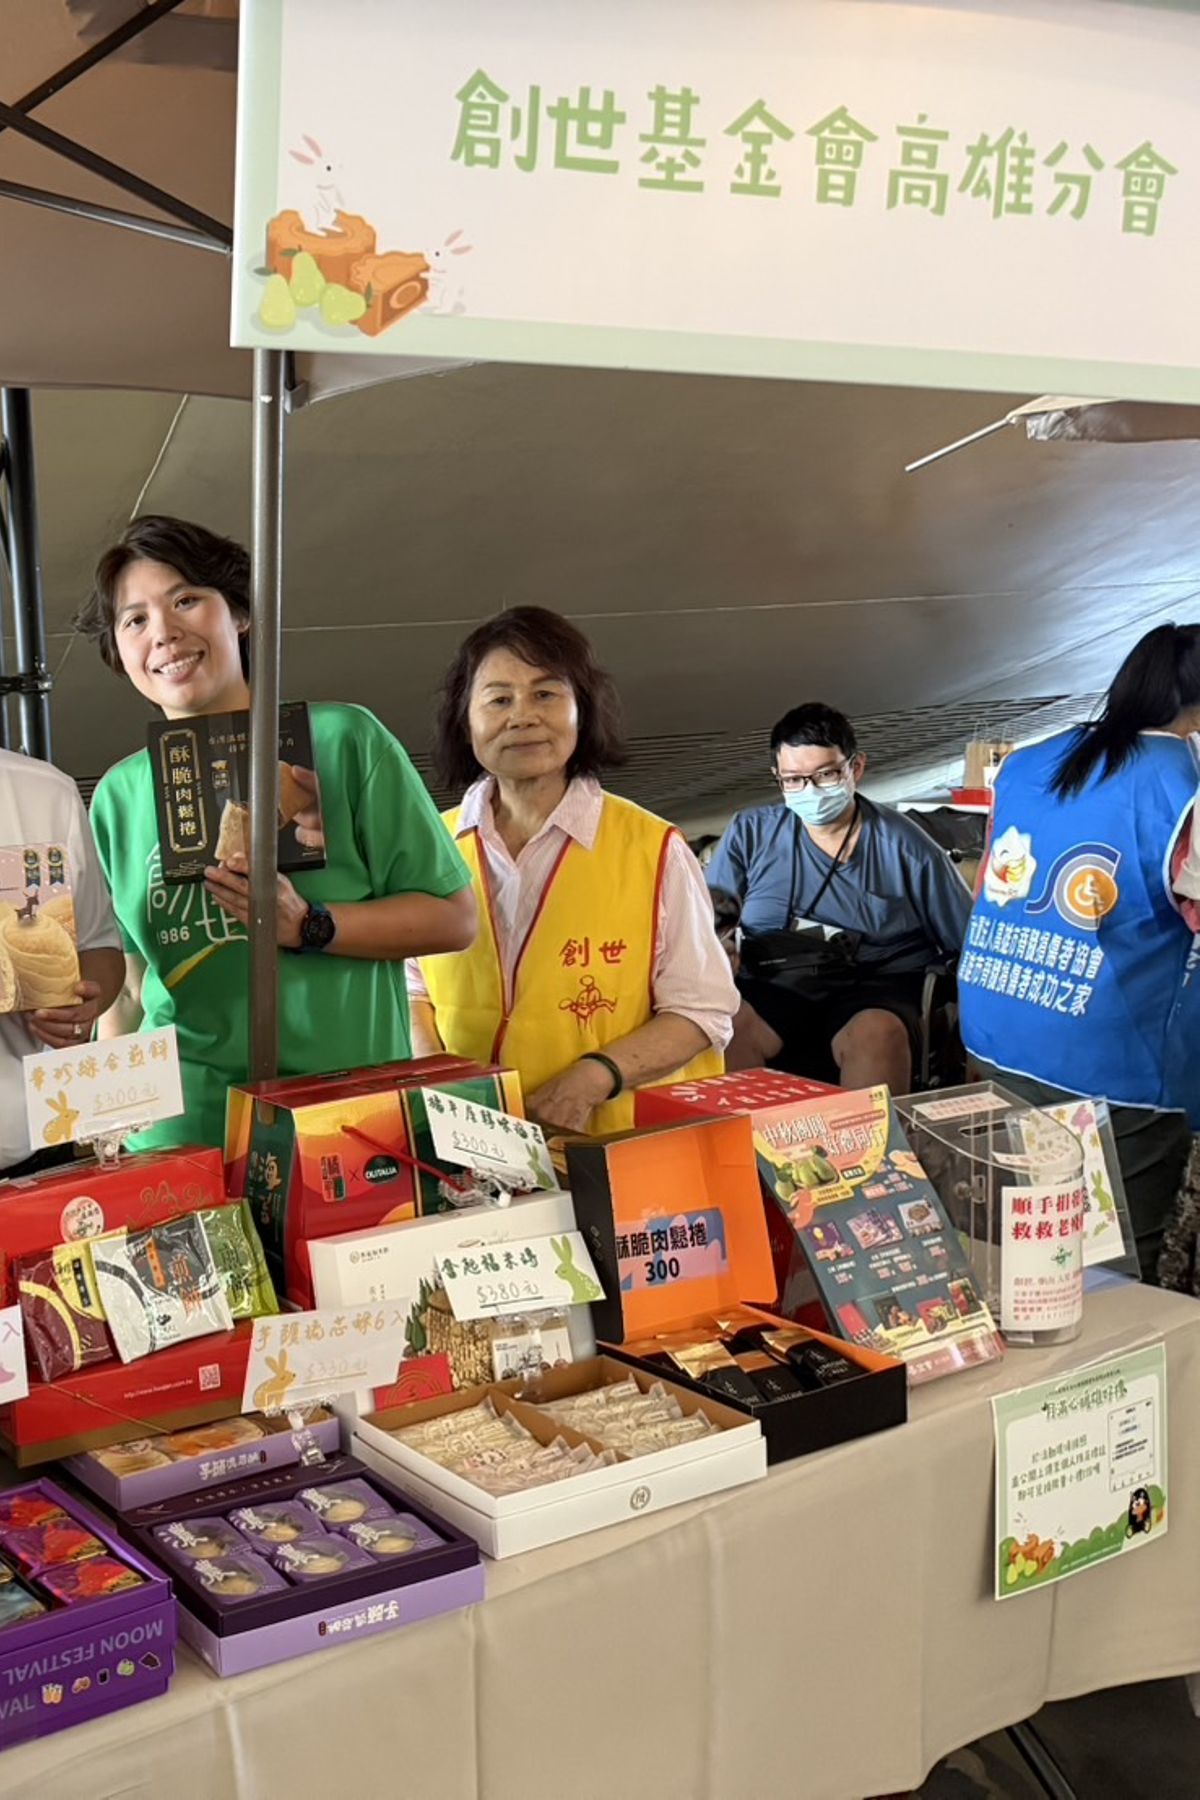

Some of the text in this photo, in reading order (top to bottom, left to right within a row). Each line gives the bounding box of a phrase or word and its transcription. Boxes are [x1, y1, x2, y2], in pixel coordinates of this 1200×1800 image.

[450, 69, 1178, 236] 創世基金會高雄分會
[559, 936, 627, 967] 創世
[365, 1165, 398, 1182] OLITALIA
[645, 1257, 680, 1282] 300
[4, 1618, 165, 1687] MOON FESTIVAL
